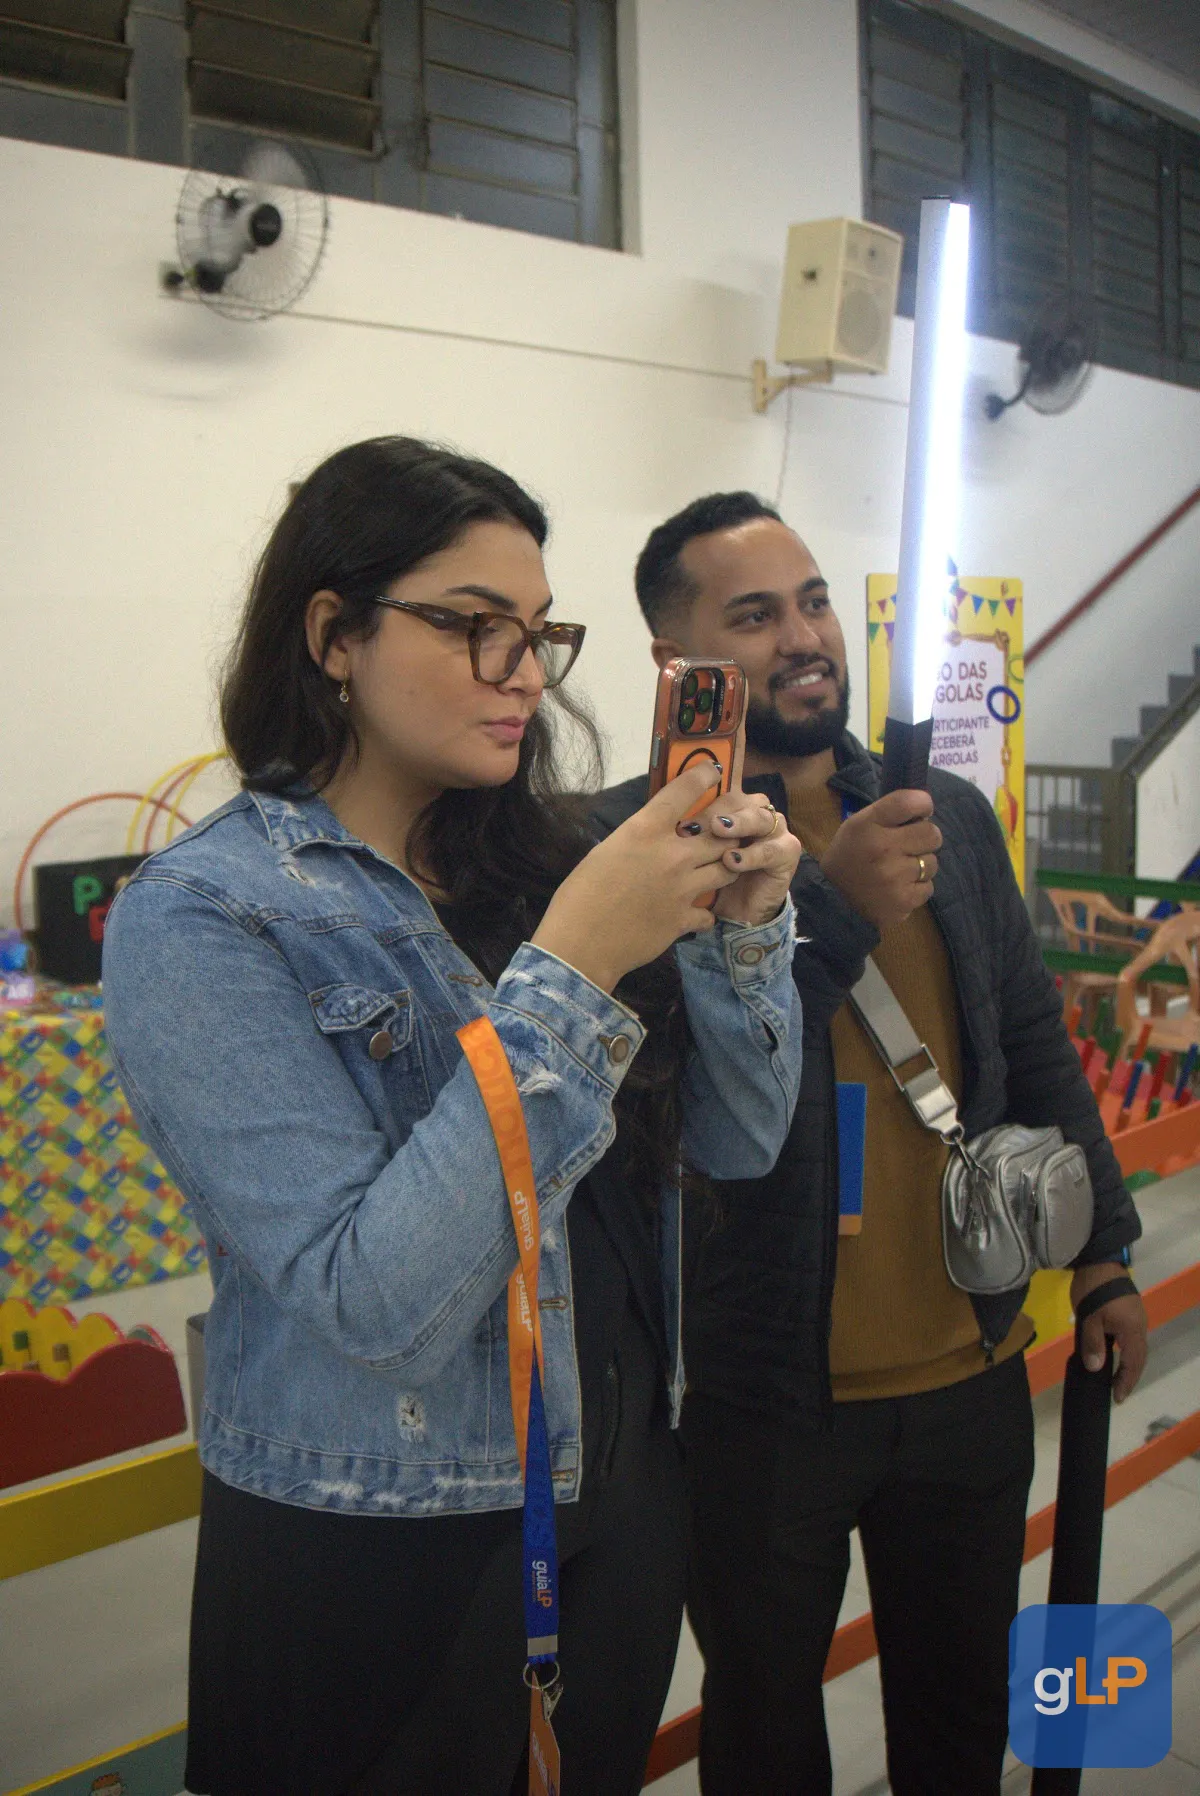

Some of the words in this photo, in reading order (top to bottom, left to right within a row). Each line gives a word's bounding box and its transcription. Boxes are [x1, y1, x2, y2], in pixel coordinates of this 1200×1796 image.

[958, 662, 988, 681] DAS
[935, 684, 983, 703] GOLAS
[932, 716, 989, 732] RTICIPANTE
[931, 734, 975, 750] ECEBERÁ
[932, 752, 978, 766] ARGOLAS
[514, 1190, 535, 1251] guiaLP
[532, 1560, 552, 1608] guiaLP
